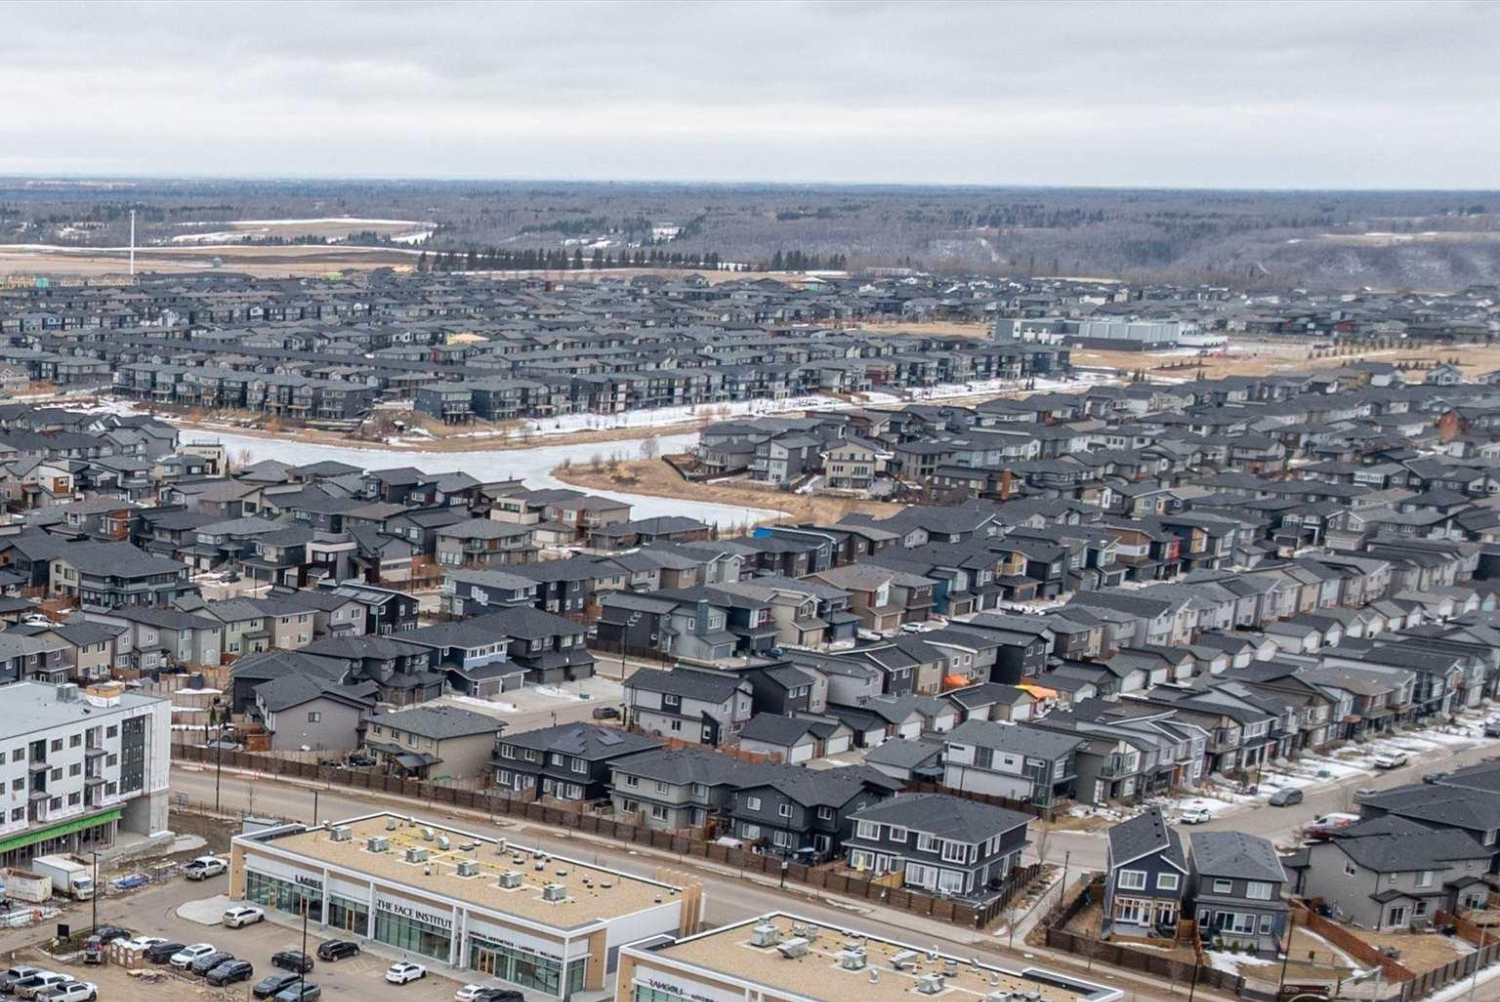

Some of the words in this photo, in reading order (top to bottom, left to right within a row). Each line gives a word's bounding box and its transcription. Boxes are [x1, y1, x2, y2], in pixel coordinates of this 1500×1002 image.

[377, 899, 393, 912] THE
[394, 904, 414, 918] FACE
[415, 910, 452, 929] INSTITUT
